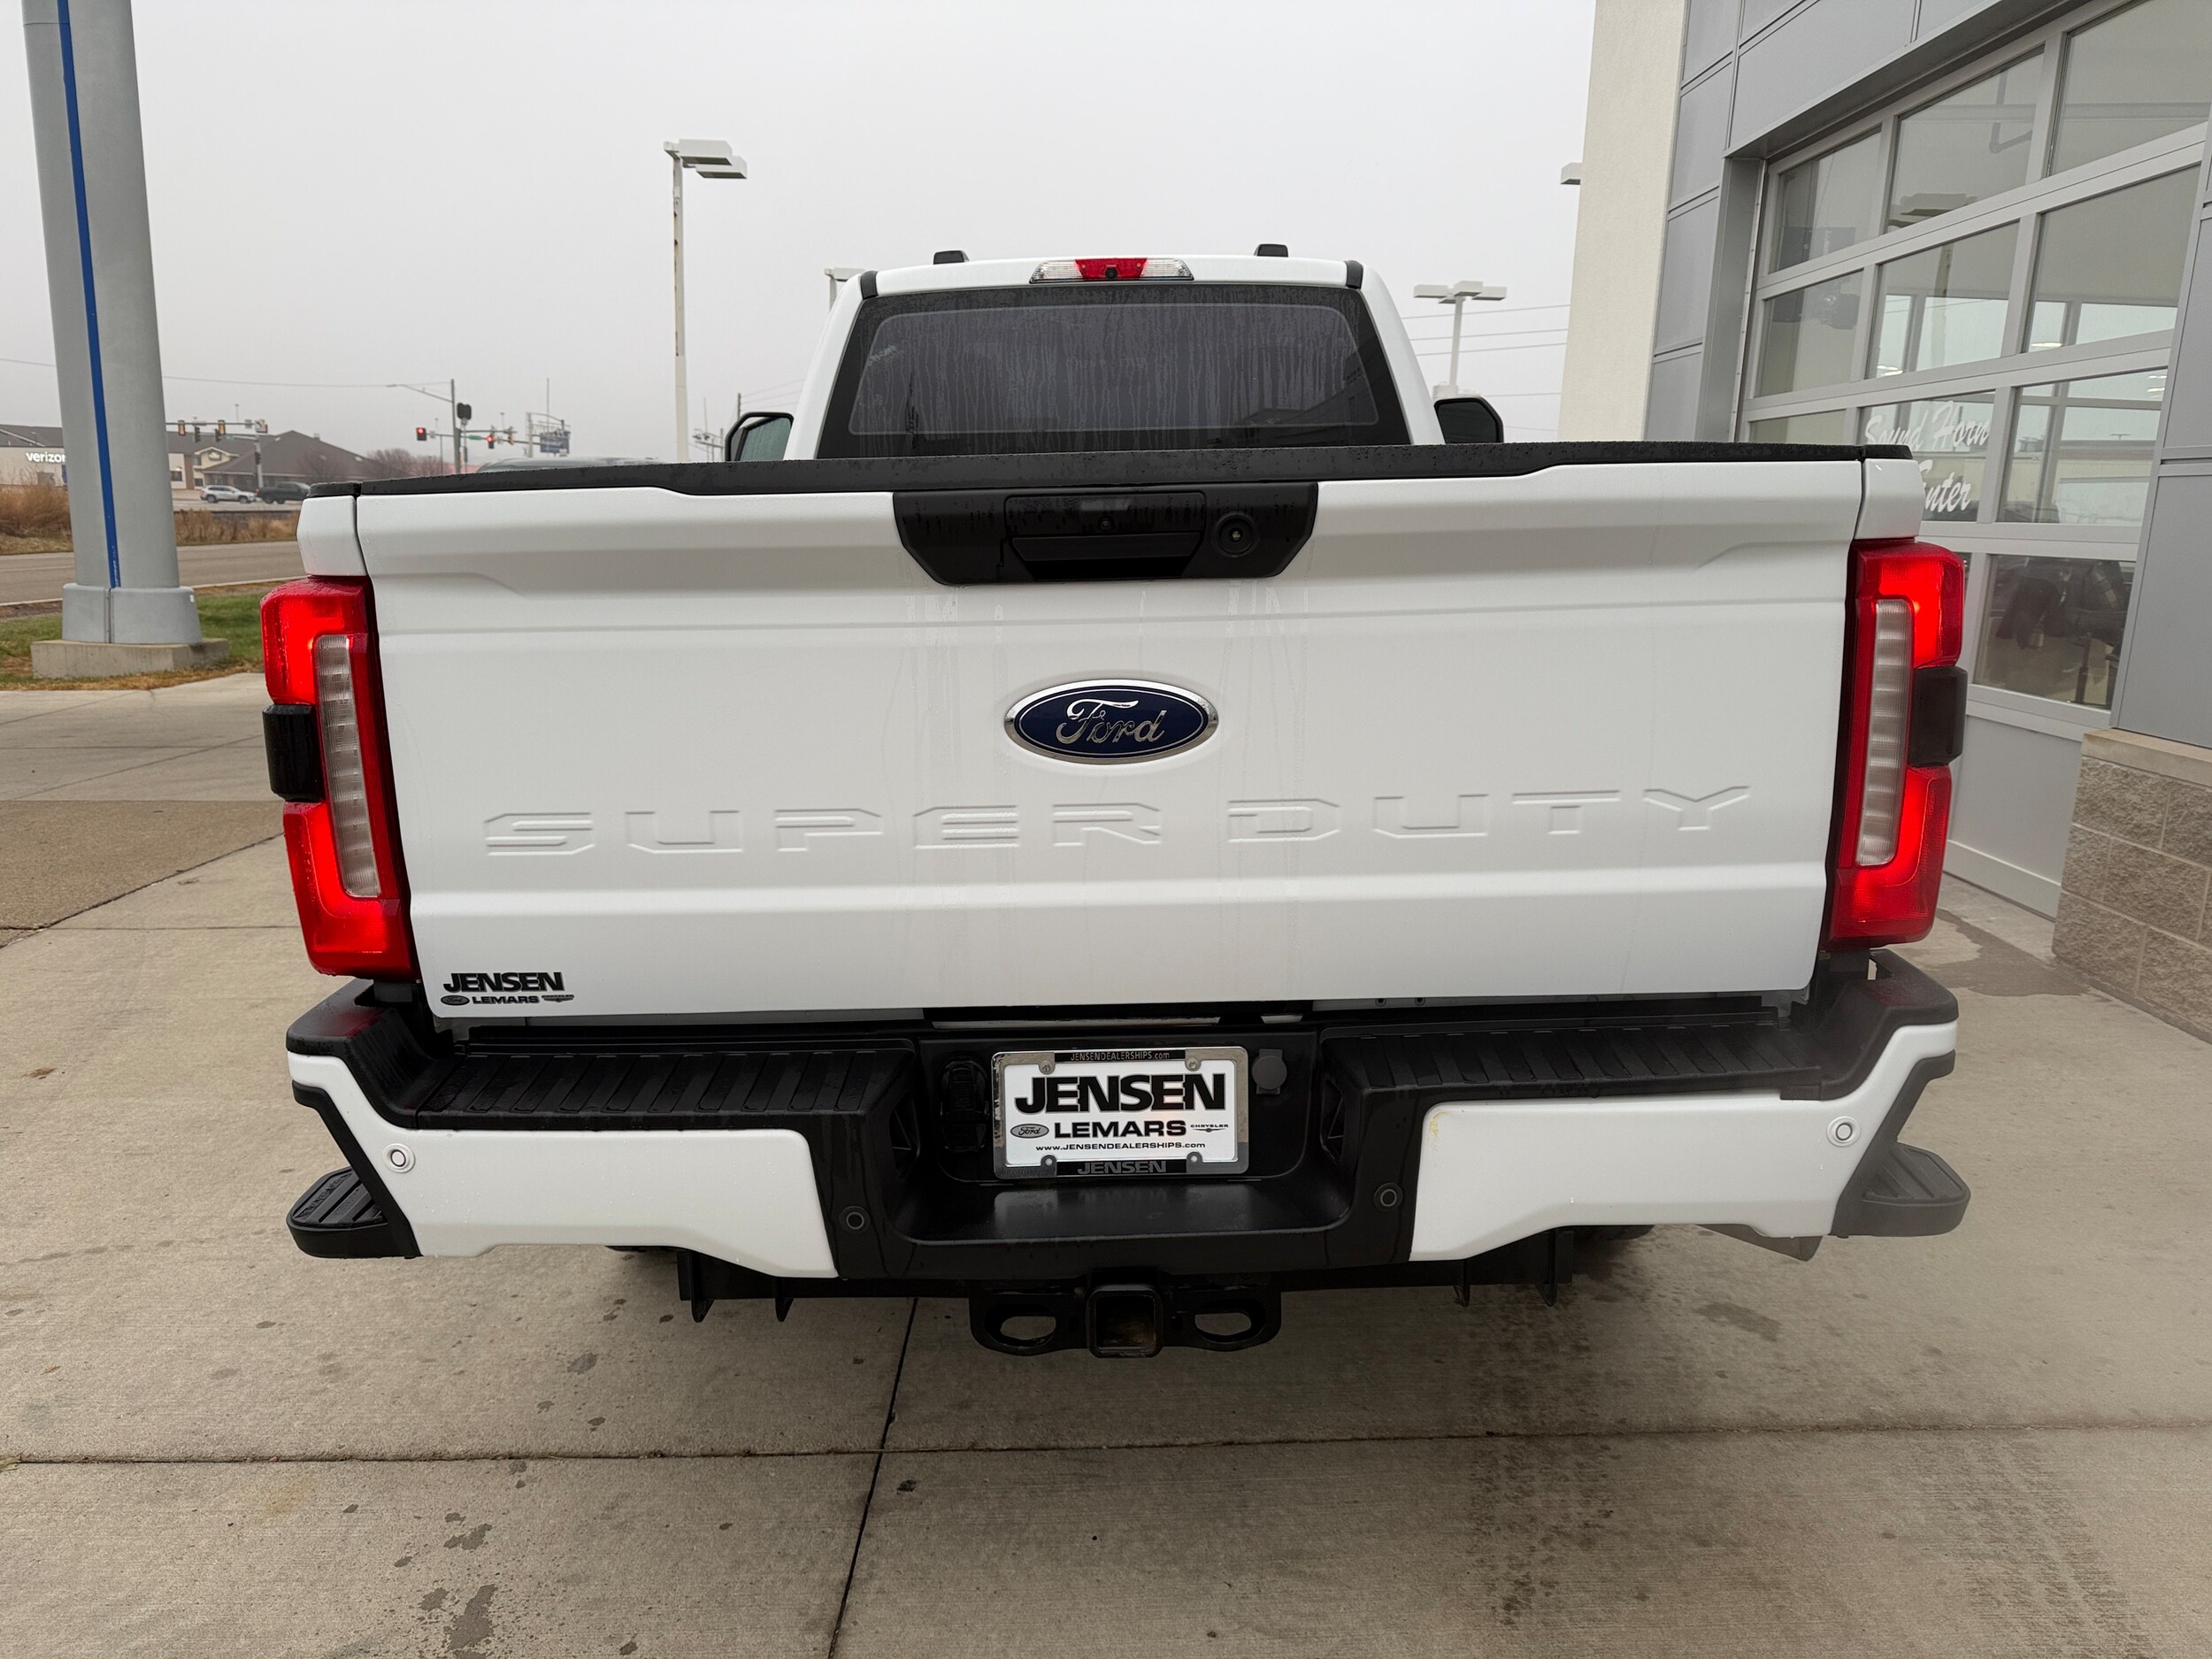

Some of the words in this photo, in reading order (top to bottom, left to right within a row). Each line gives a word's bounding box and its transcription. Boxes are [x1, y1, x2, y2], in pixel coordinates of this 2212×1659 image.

[1865, 409, 1929, 450] Sound
[1932, 400, 1990, 449] Horn
[1918, 459, 1971, 512] nter
[1056, 698, 1167, 744] Ford
[484, 803, 1161, 856] SUPER
[1228, 785, 1750, 842] DUTY
[443, 972, 565, 993] JENSEN
[472, 995, 540, 1004] LEMARS
[1070, 1050, 1170, 1062] JENSENDEALERSHIPS.com
[1014, 1073, 1225, 1114] JENSEN
[1054, 1120, 1187, 1139] LEMARS
[1035, 1141, 1205, 1151] www.JENSENDEALERSHIPS.com
[1077, 1160, 1166, 1175] JENSEN
